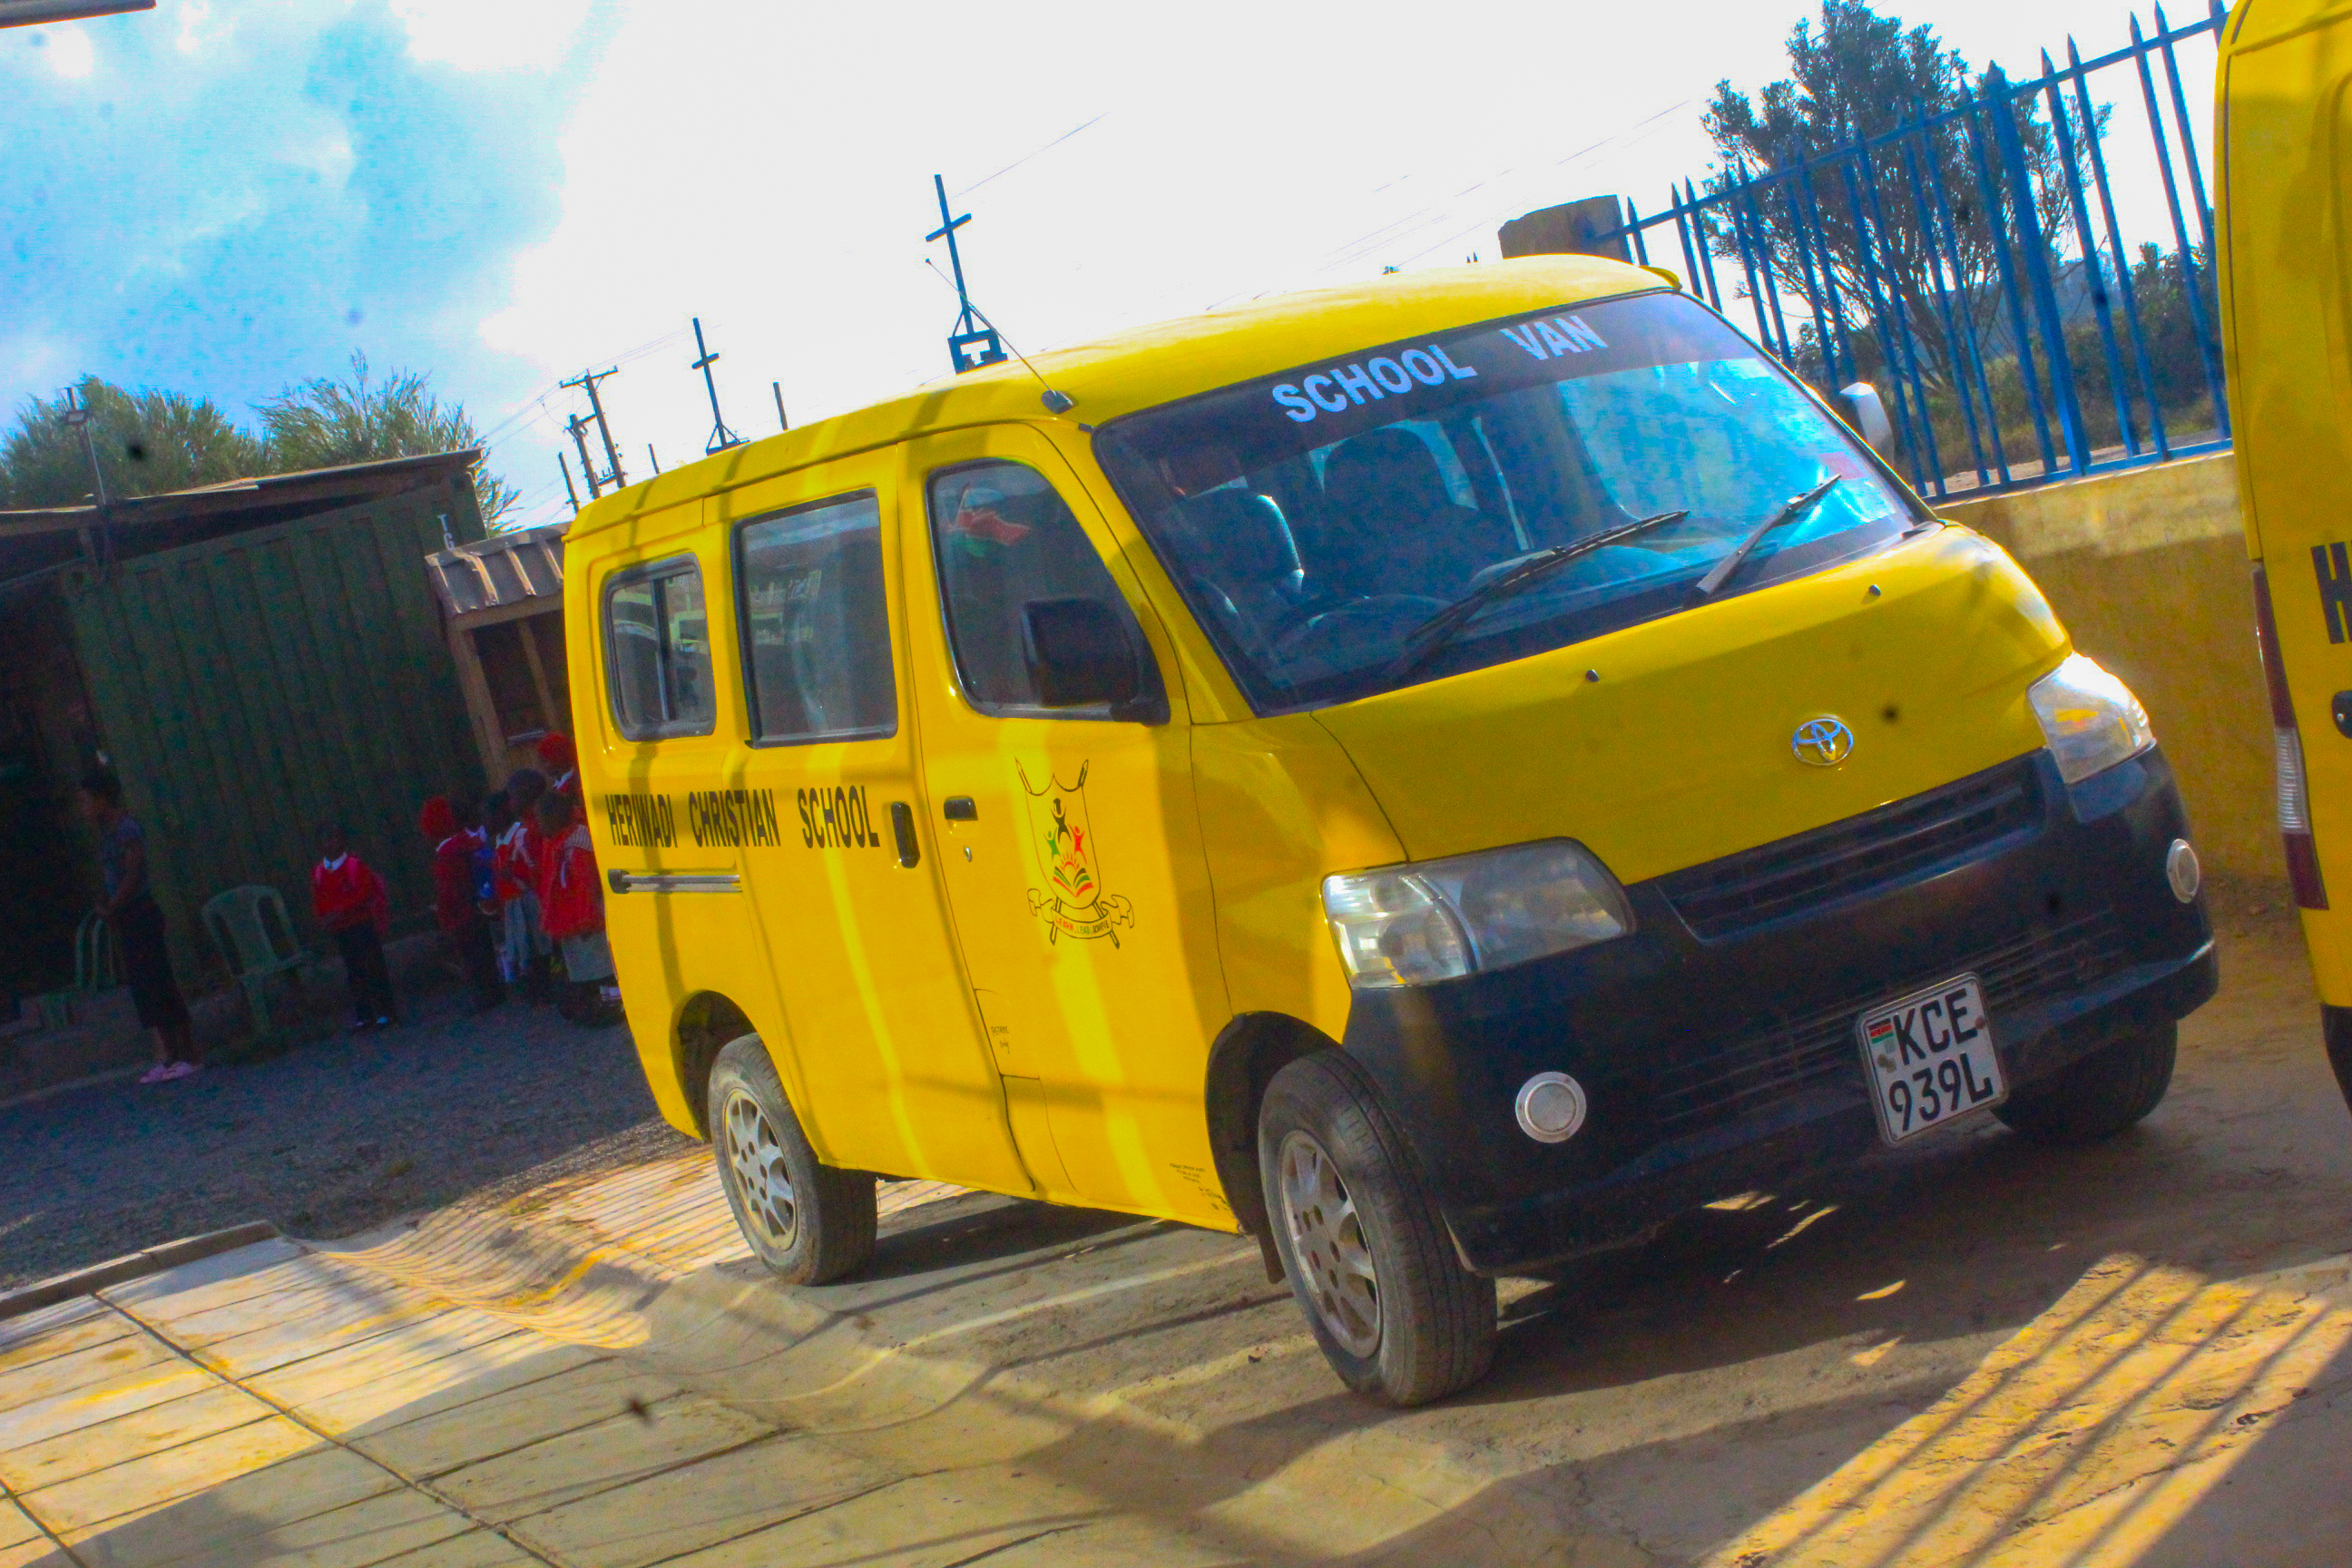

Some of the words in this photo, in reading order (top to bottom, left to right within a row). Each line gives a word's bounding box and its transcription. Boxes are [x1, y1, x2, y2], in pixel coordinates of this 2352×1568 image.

[1272, 344, 1478, 423] SCHOOL
[1499, 315, 1609, 361] VAN
[688, 788, 781, 848] CHRISTIAN
[798, 784, 881, 849] SCHOOL
[1892, 987, 1978, 1066] KCE
[1888, 1052, 1994, 1132] 939L
